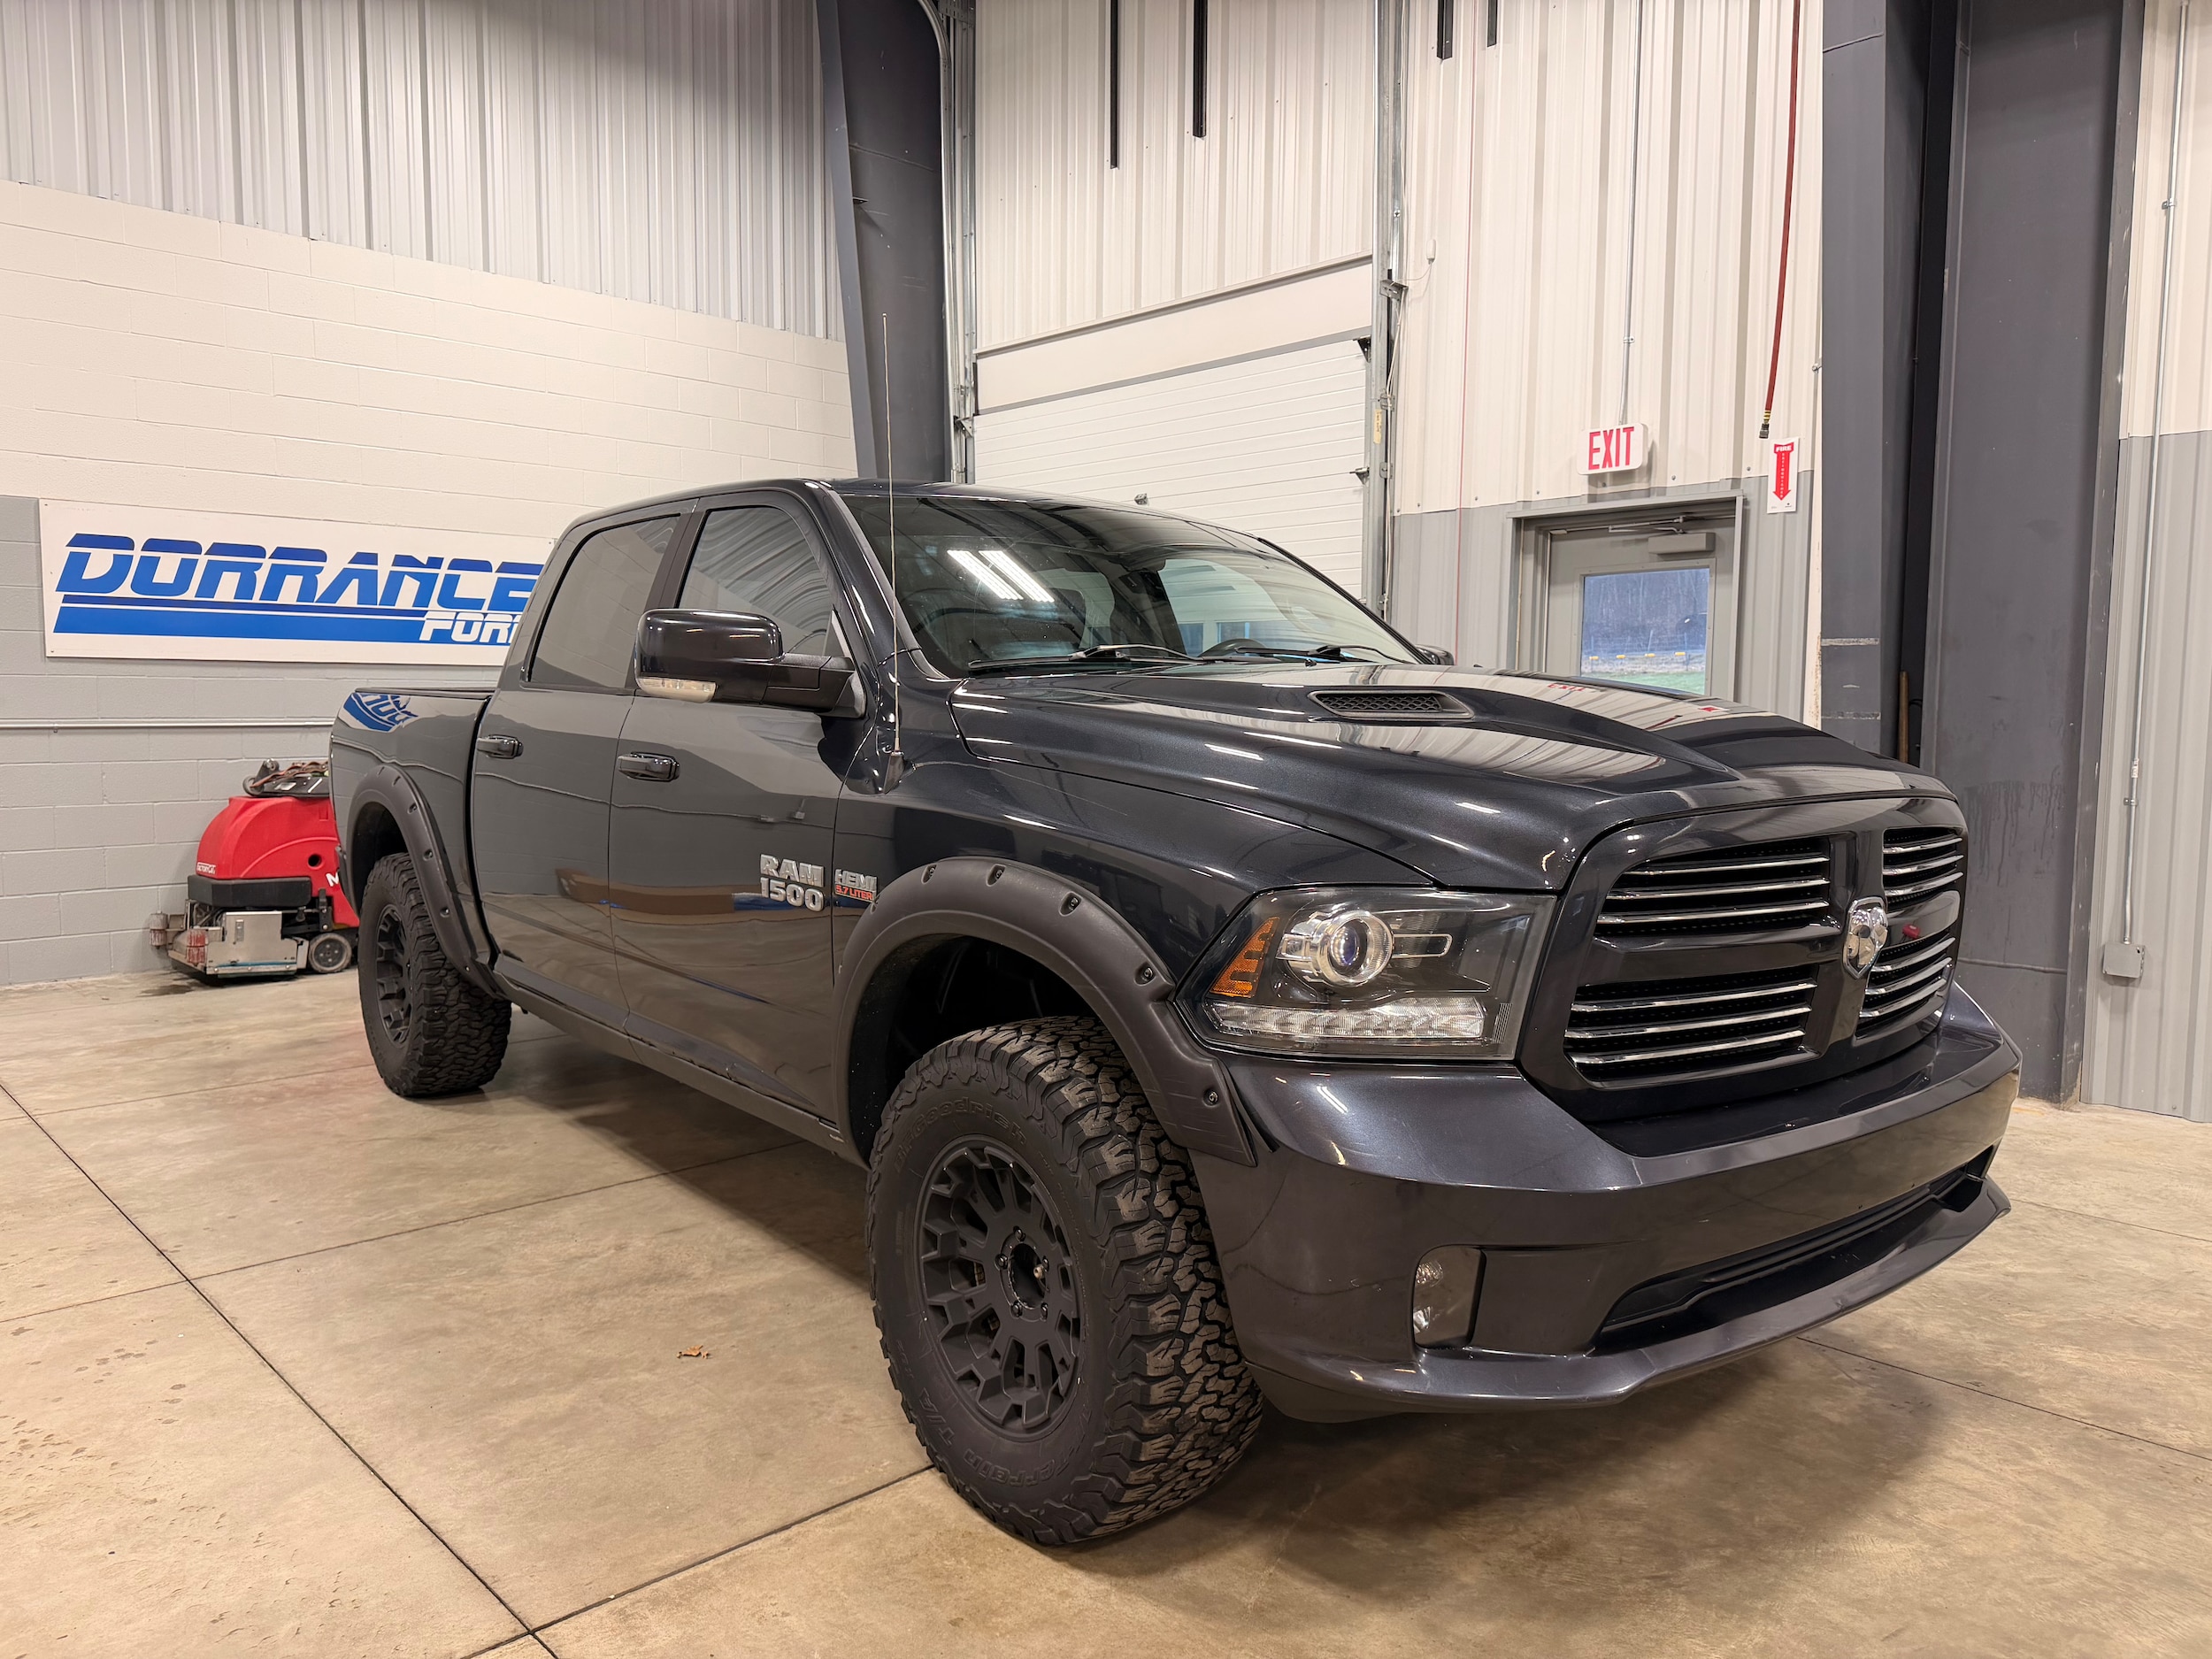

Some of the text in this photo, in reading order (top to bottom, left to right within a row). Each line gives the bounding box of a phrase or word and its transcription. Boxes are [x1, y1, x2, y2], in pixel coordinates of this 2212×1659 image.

[1588, 426, 1634, 471] EXIT
[55, 533, 544, 611] DORRANCE
[760, 854, 825, 887] RAM
[834, 869, 877, 891] HEMI
[760, 877, 825, 912] 1500
[836, 885, 872, 901] 5.7 LITER
